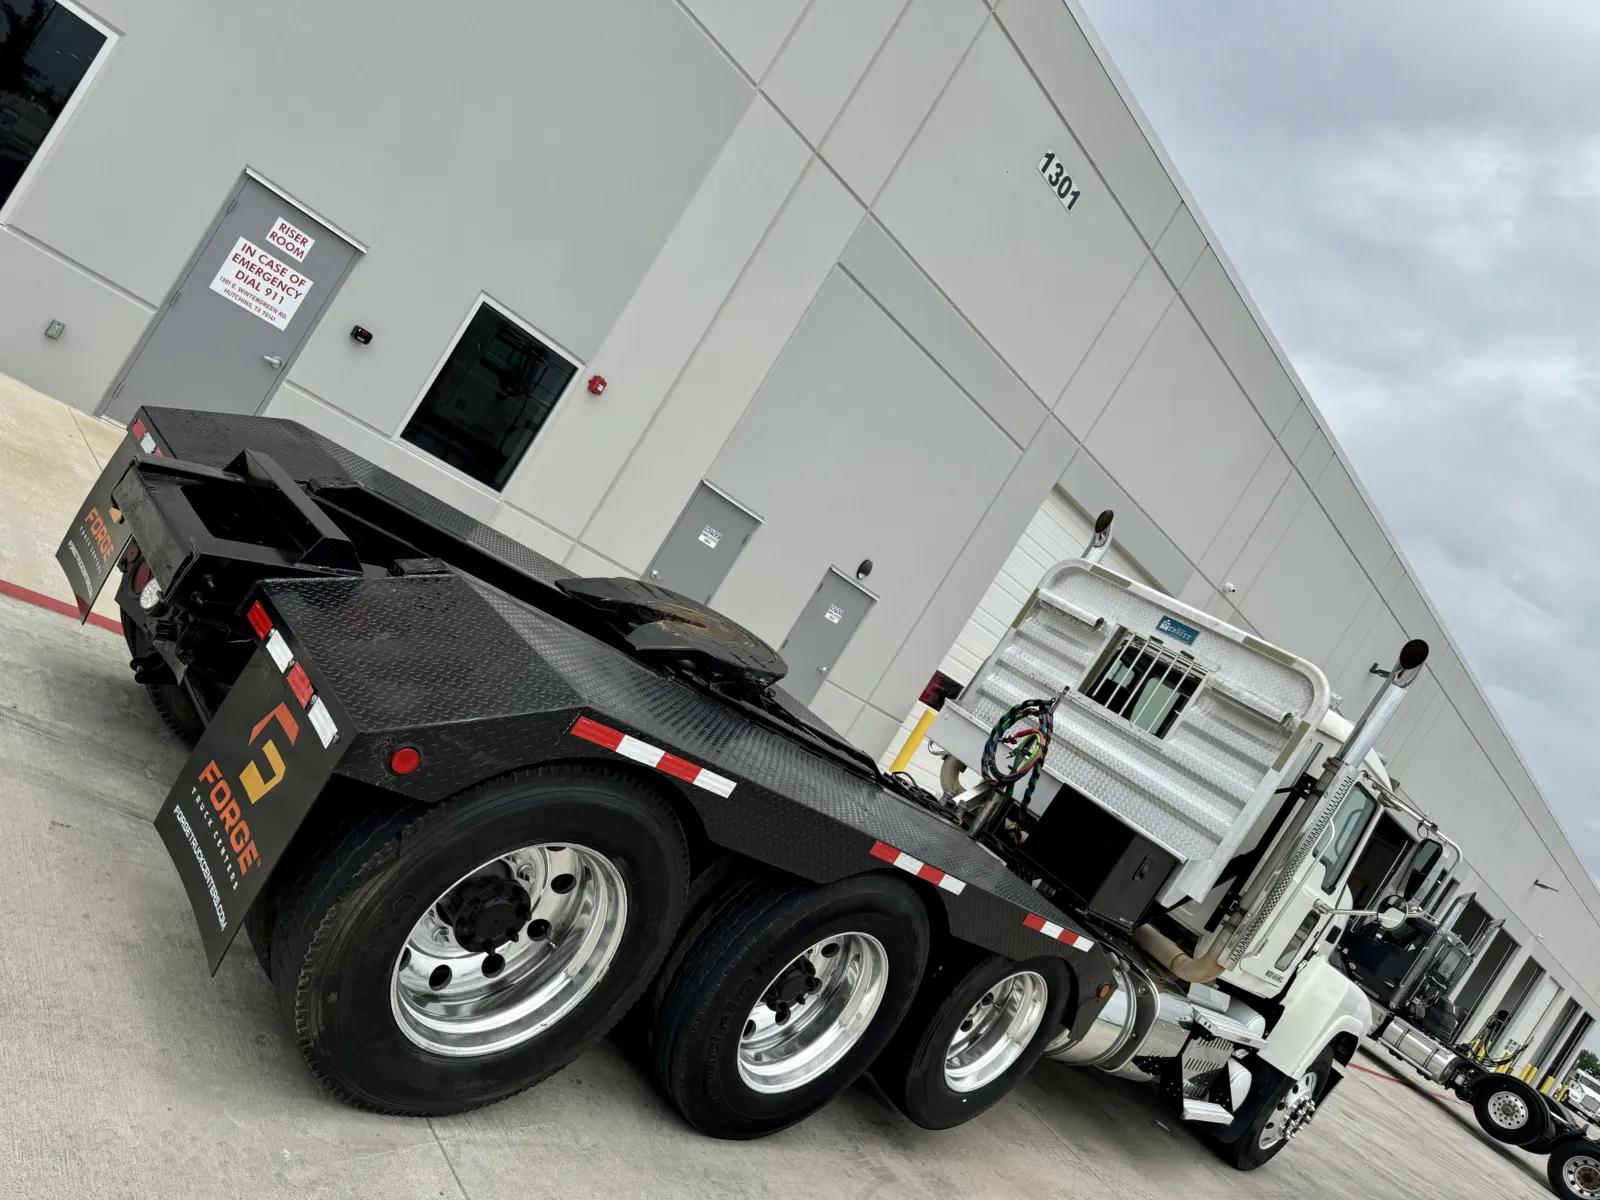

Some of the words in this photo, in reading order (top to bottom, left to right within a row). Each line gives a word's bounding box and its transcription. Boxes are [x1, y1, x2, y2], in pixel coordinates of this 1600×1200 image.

[1041, 152, 1081, 211] 1301
[269, 231, 305, 259] ROOM
[278, 222, 309, 247] RISER
[231, 252, 303, 300] EMERGENCY
[235, 270, 261, 292] DIAL
[265, 288, 285, 305] 911
[241, 243, 257, 257] IN
[258, 254, 288, 277] CASE
[289, 274, 307, 287] OF
[223, 288, 253, 310] HUTCHINS,
[238, 287, 278, 315] WINTERGREEN
[278, 311, 288, 320] RD.
[84, 506, 114, 564] FORGE
[191, 786, 214, 828] TRUCK
[213, 830, 239, 891] CENTERS
[198, 759, 259, 877] FORGE
[173, 804, 228, 932] FORGETRUCKCENTERS.COM
